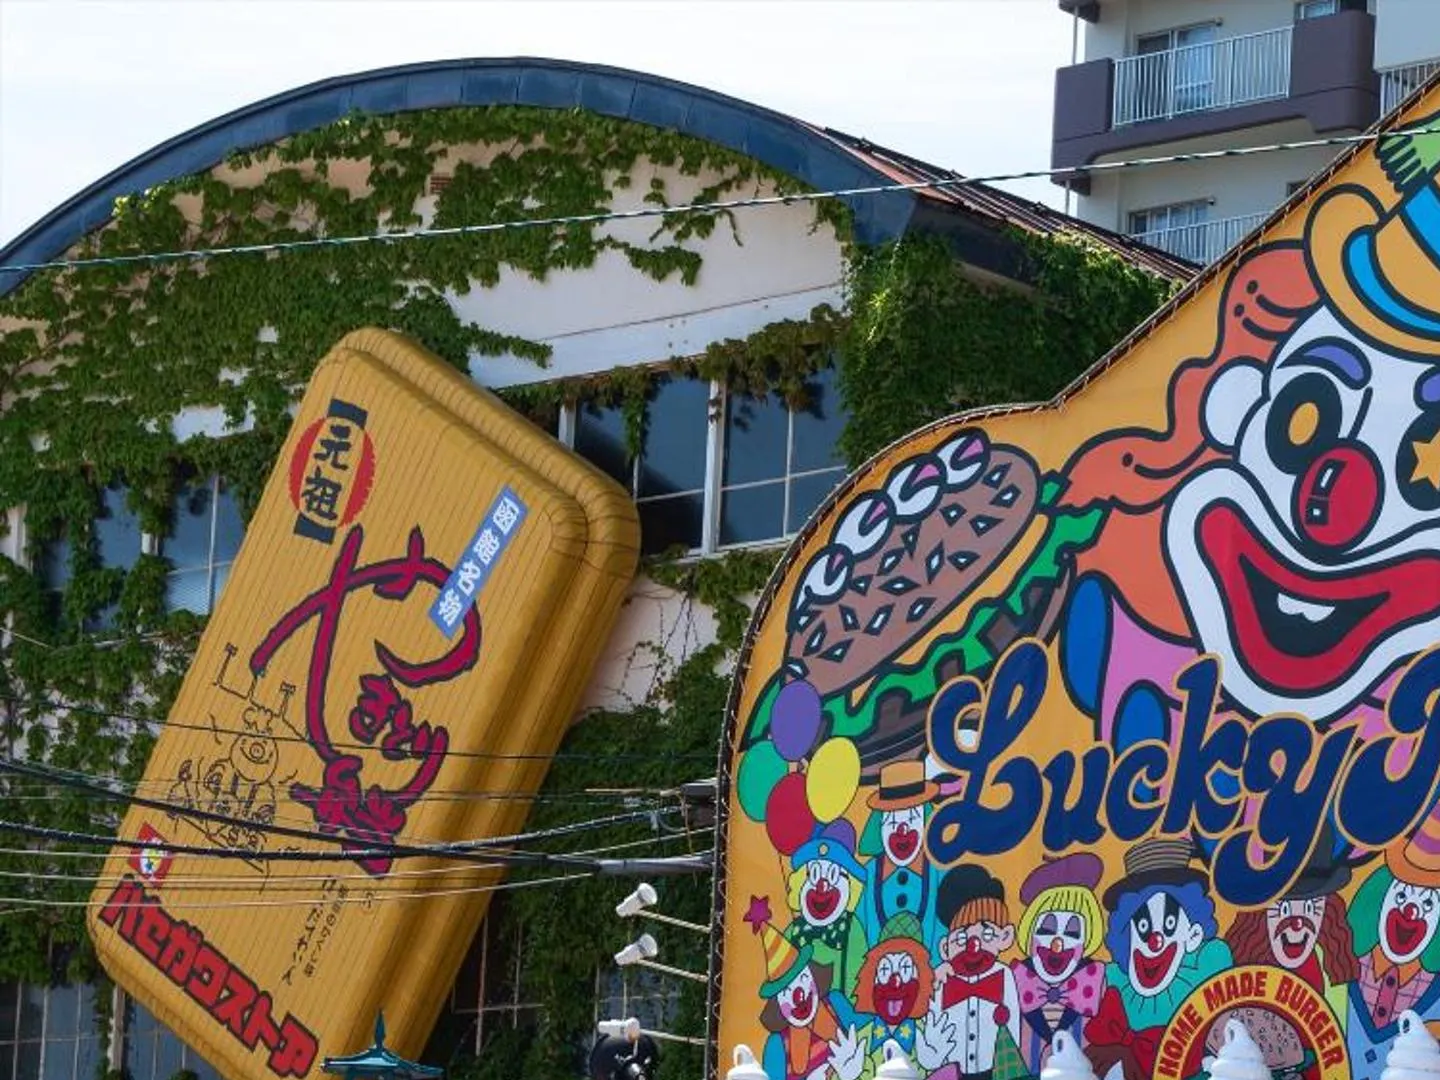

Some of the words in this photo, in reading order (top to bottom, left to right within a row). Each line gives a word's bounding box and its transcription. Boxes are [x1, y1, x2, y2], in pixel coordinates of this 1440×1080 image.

[301, 424, 352, 522] 元祖
[928, 637, 1352, 907] Lucky
[1158, 1003, 1203, 1078] HOME
[1203, 971, 1268, 1012] MADE
[1274, 974, 1345, 1069] BURGER
